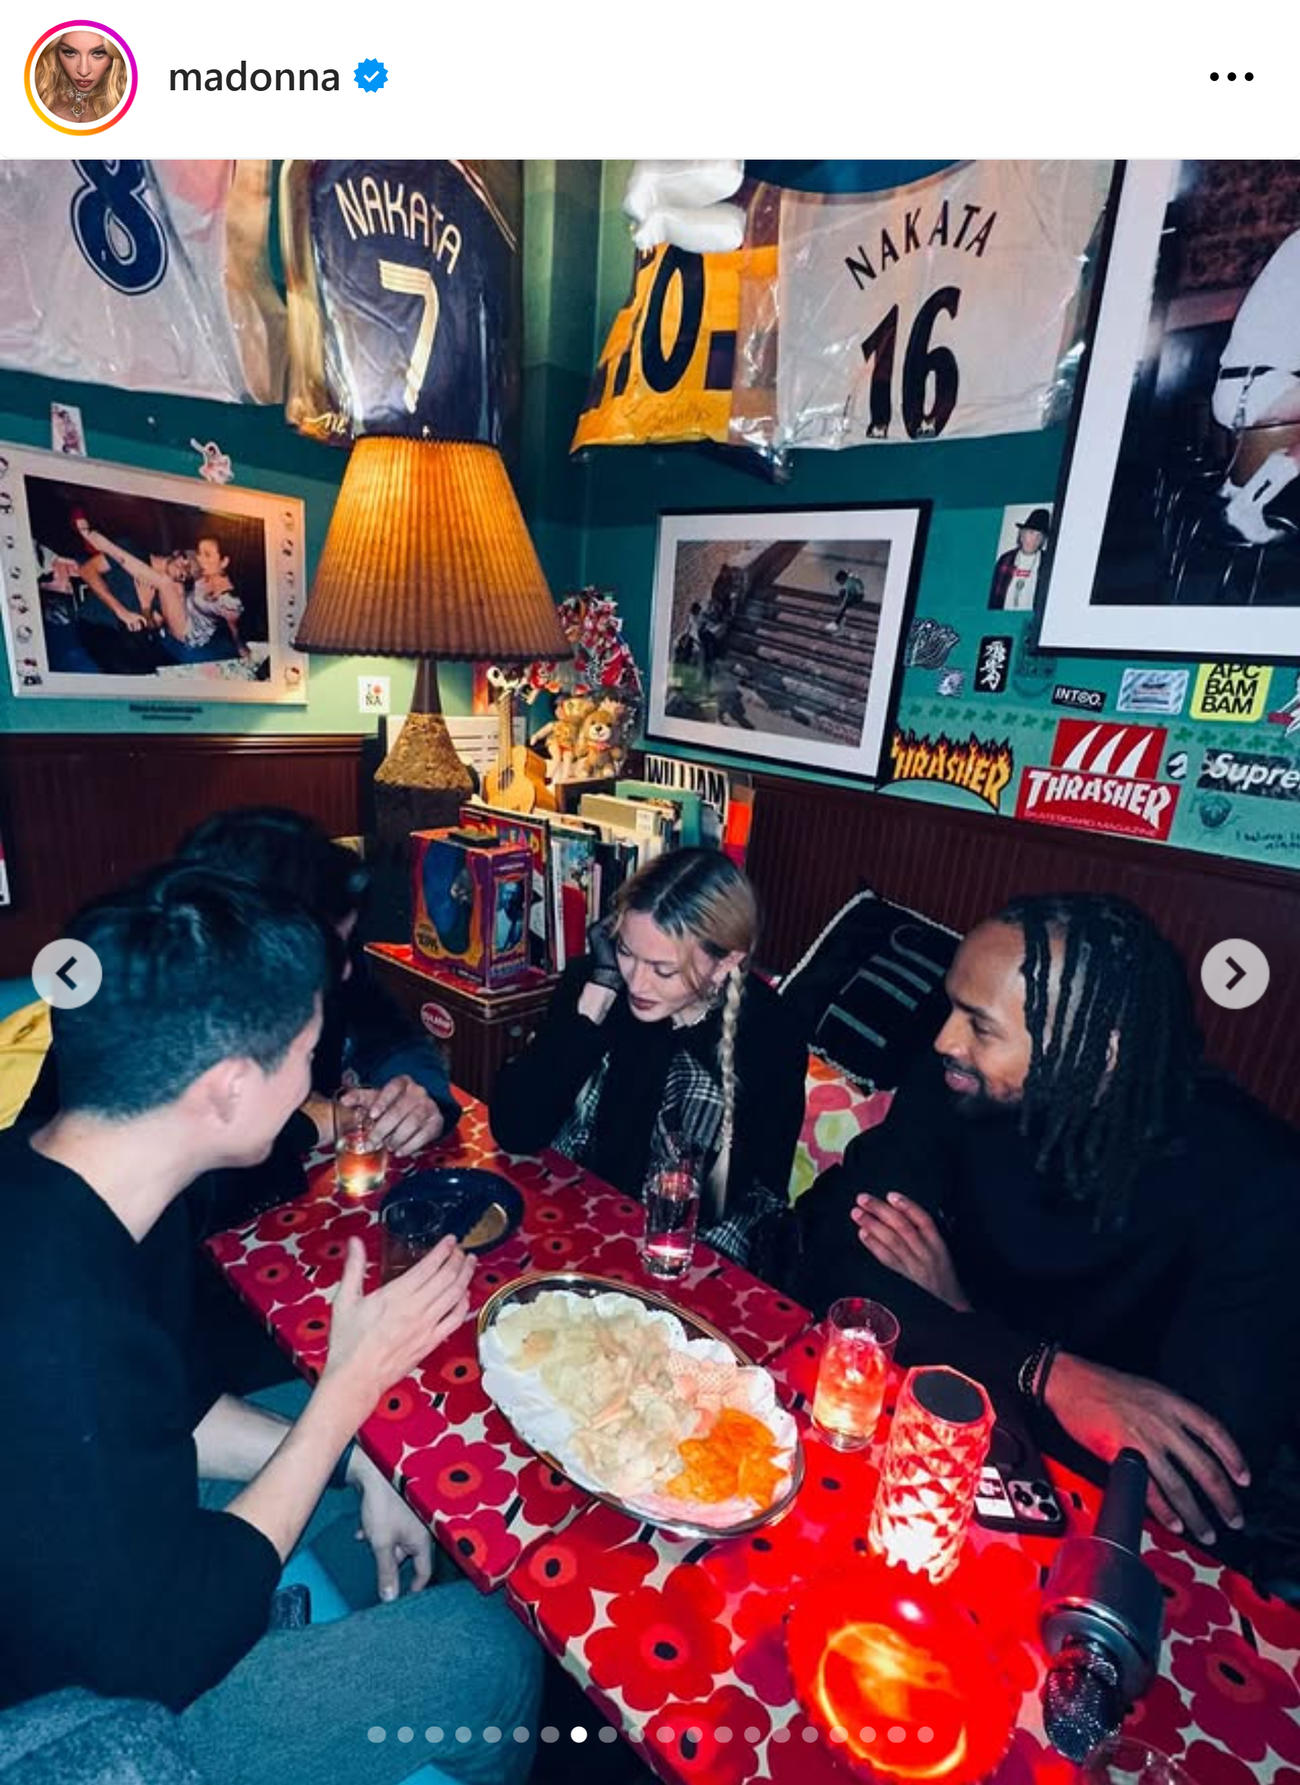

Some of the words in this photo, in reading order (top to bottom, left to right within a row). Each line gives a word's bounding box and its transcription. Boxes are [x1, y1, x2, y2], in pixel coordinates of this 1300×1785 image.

[334, 177, 463, 275] NAKATA
[844, 199, 998, 291] NAKATA
[378, 258, 440, 414] 7
[861, 286, 962, 441] 16
[1205, 678, 1258, 698] BAM
[1208, 663, 1261, 680] APC
[1201, 695, 1254, 715] BAM
[647, 756, 727, 816] WILLIAM
[1026, 770, 1172, 829] THRASHER
[1209, 752, 1300, 791] Supre
